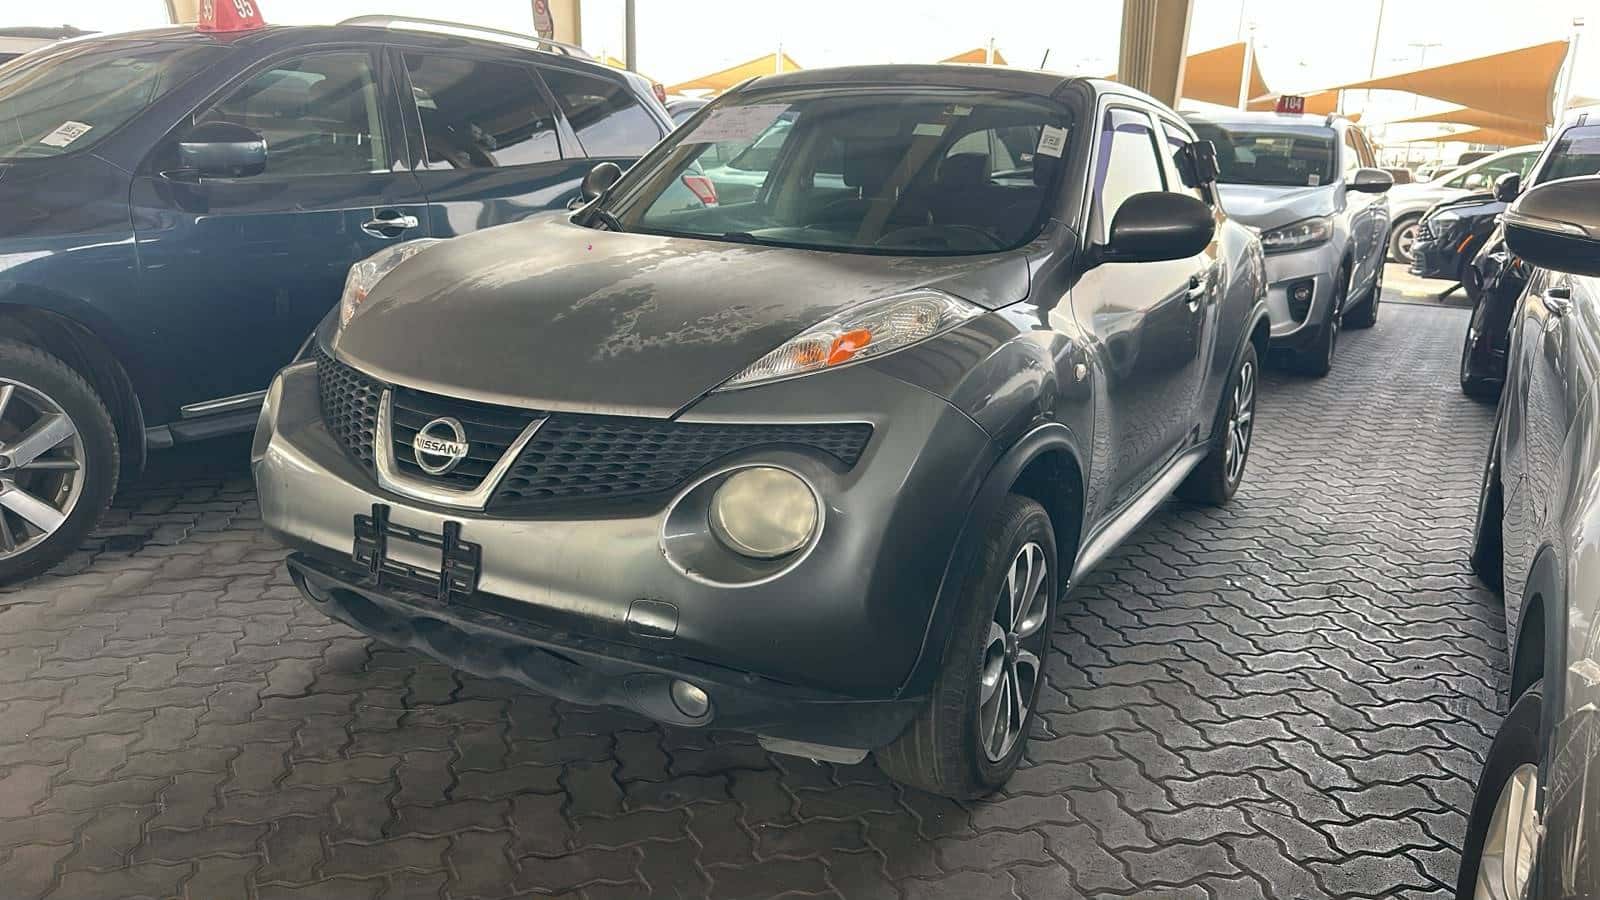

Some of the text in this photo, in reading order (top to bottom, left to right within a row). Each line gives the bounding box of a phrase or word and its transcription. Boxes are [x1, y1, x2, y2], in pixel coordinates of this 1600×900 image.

[233, 0, 254, 18] 95
[1284, 96, 1302, 110] 104
[416, 437, 459, 455] NISSAN
